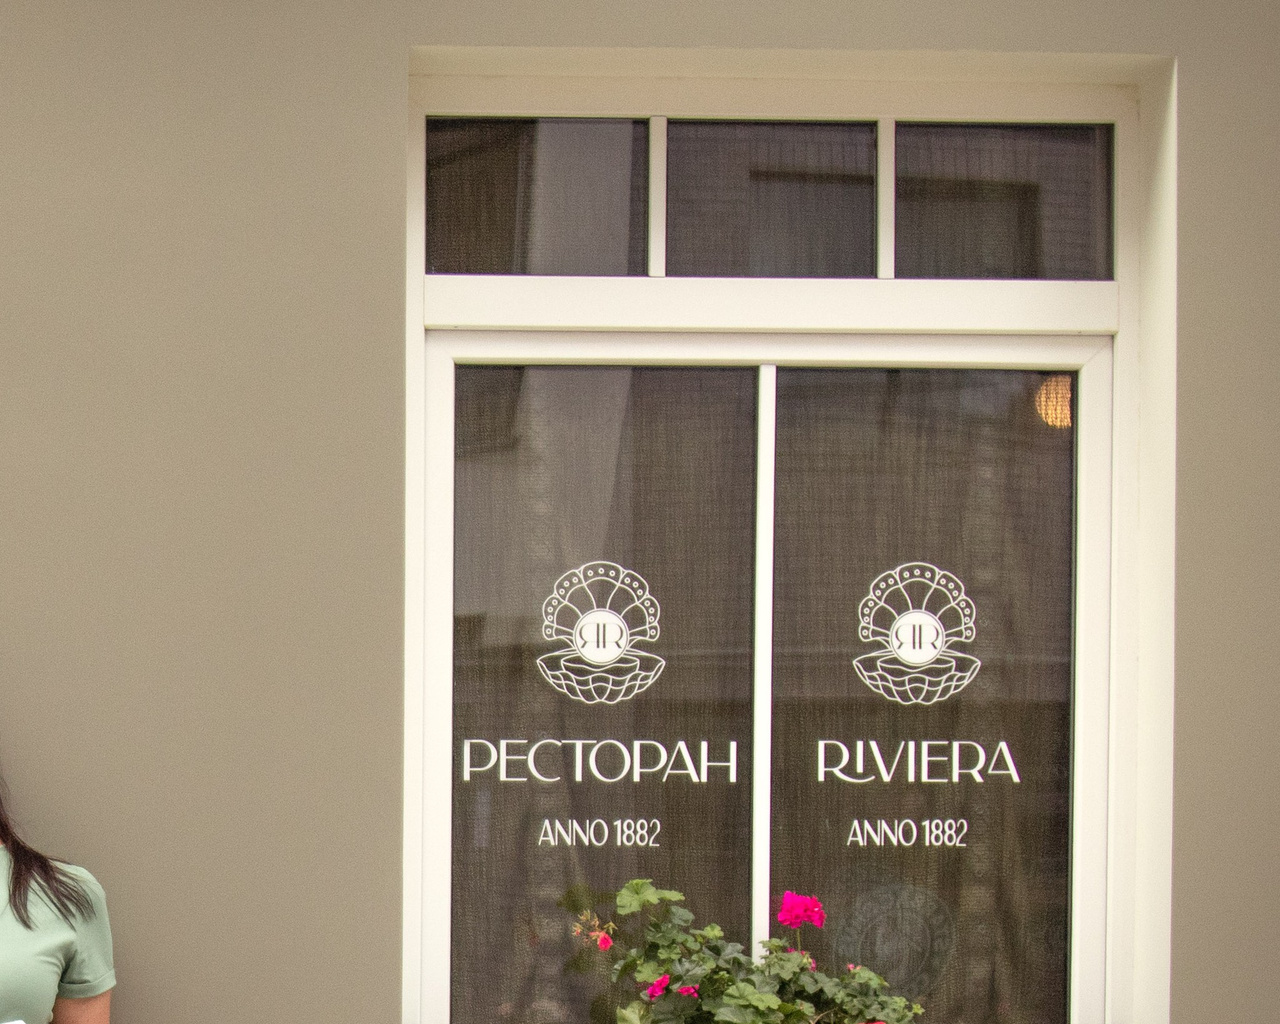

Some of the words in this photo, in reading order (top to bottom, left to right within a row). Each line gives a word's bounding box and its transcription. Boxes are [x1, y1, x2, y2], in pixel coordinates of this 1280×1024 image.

[462, 738, 738, 784] РЕСТОРАН
[817, 739, 1021, 784] RIVIERA
[537, 818, 609, 846] ANNO
[612, 818, 661, 847] 1882
[846, 818, 918, 846] ANNO
[921, 818, 968, 847] 1882
